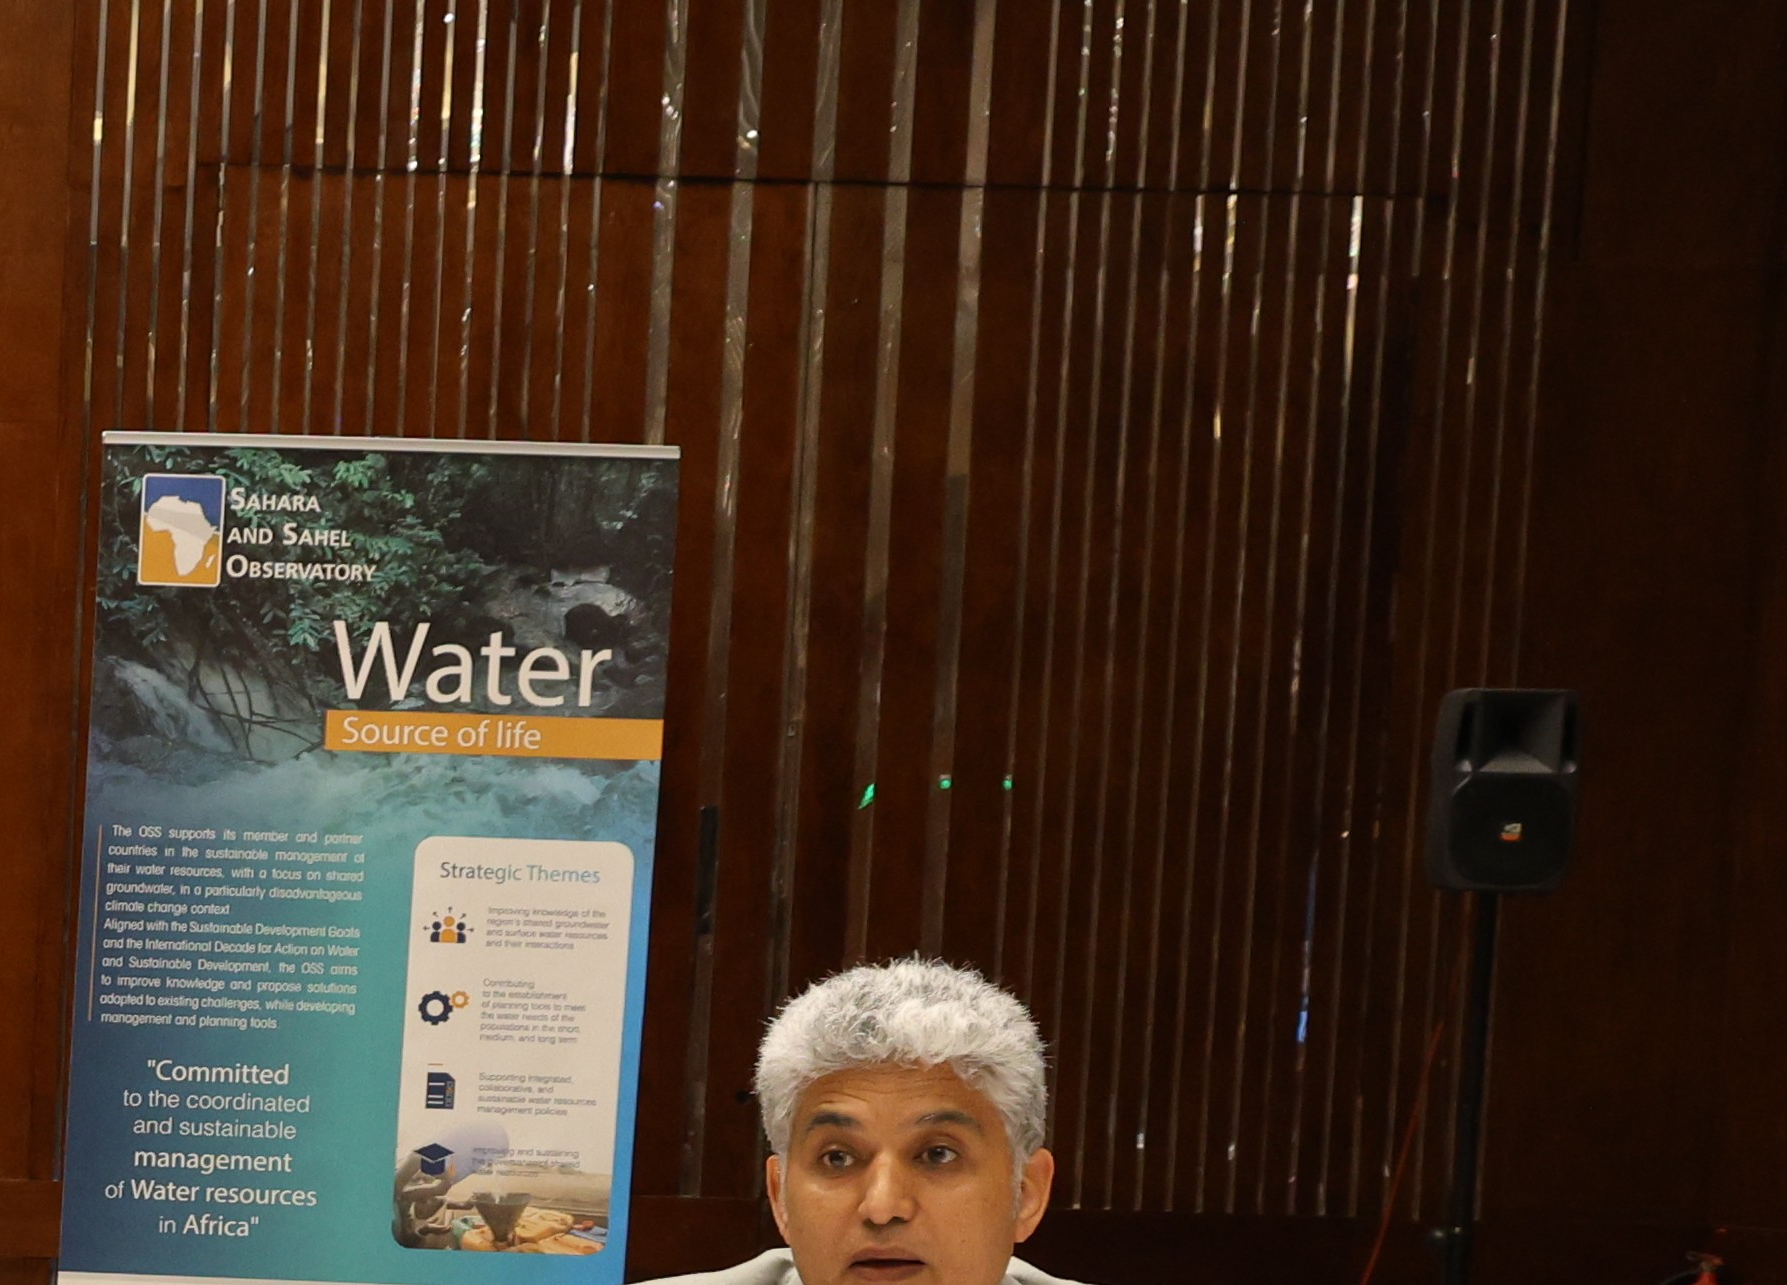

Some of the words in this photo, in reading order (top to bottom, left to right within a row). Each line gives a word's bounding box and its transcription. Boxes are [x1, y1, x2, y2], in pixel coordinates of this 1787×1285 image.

[333, 618, 612, 708] Water
[341, 716, 448, 745] Source
[457, 719, 490, 746] of
[496, 720, 541, 749] life
[439, 861, 522, 884] Strategic
[526, 864, 600, 883] Themes
[123, 1089, 142, 1106] to
[147, 1089, 180, 1108] the
[185, 1092, 310, 1112] coordinated
[132, 1116, 172, 1134] and
[178, 1119, 296, 1139] sustainable
[134, 1151, 292, 1174] management
[104, 1180, 125, 1198] of
[130, 1179, 200, 1201] Water
[205, 1187, 316, 1205] resources
[159, 1215, 176, 1233] in
